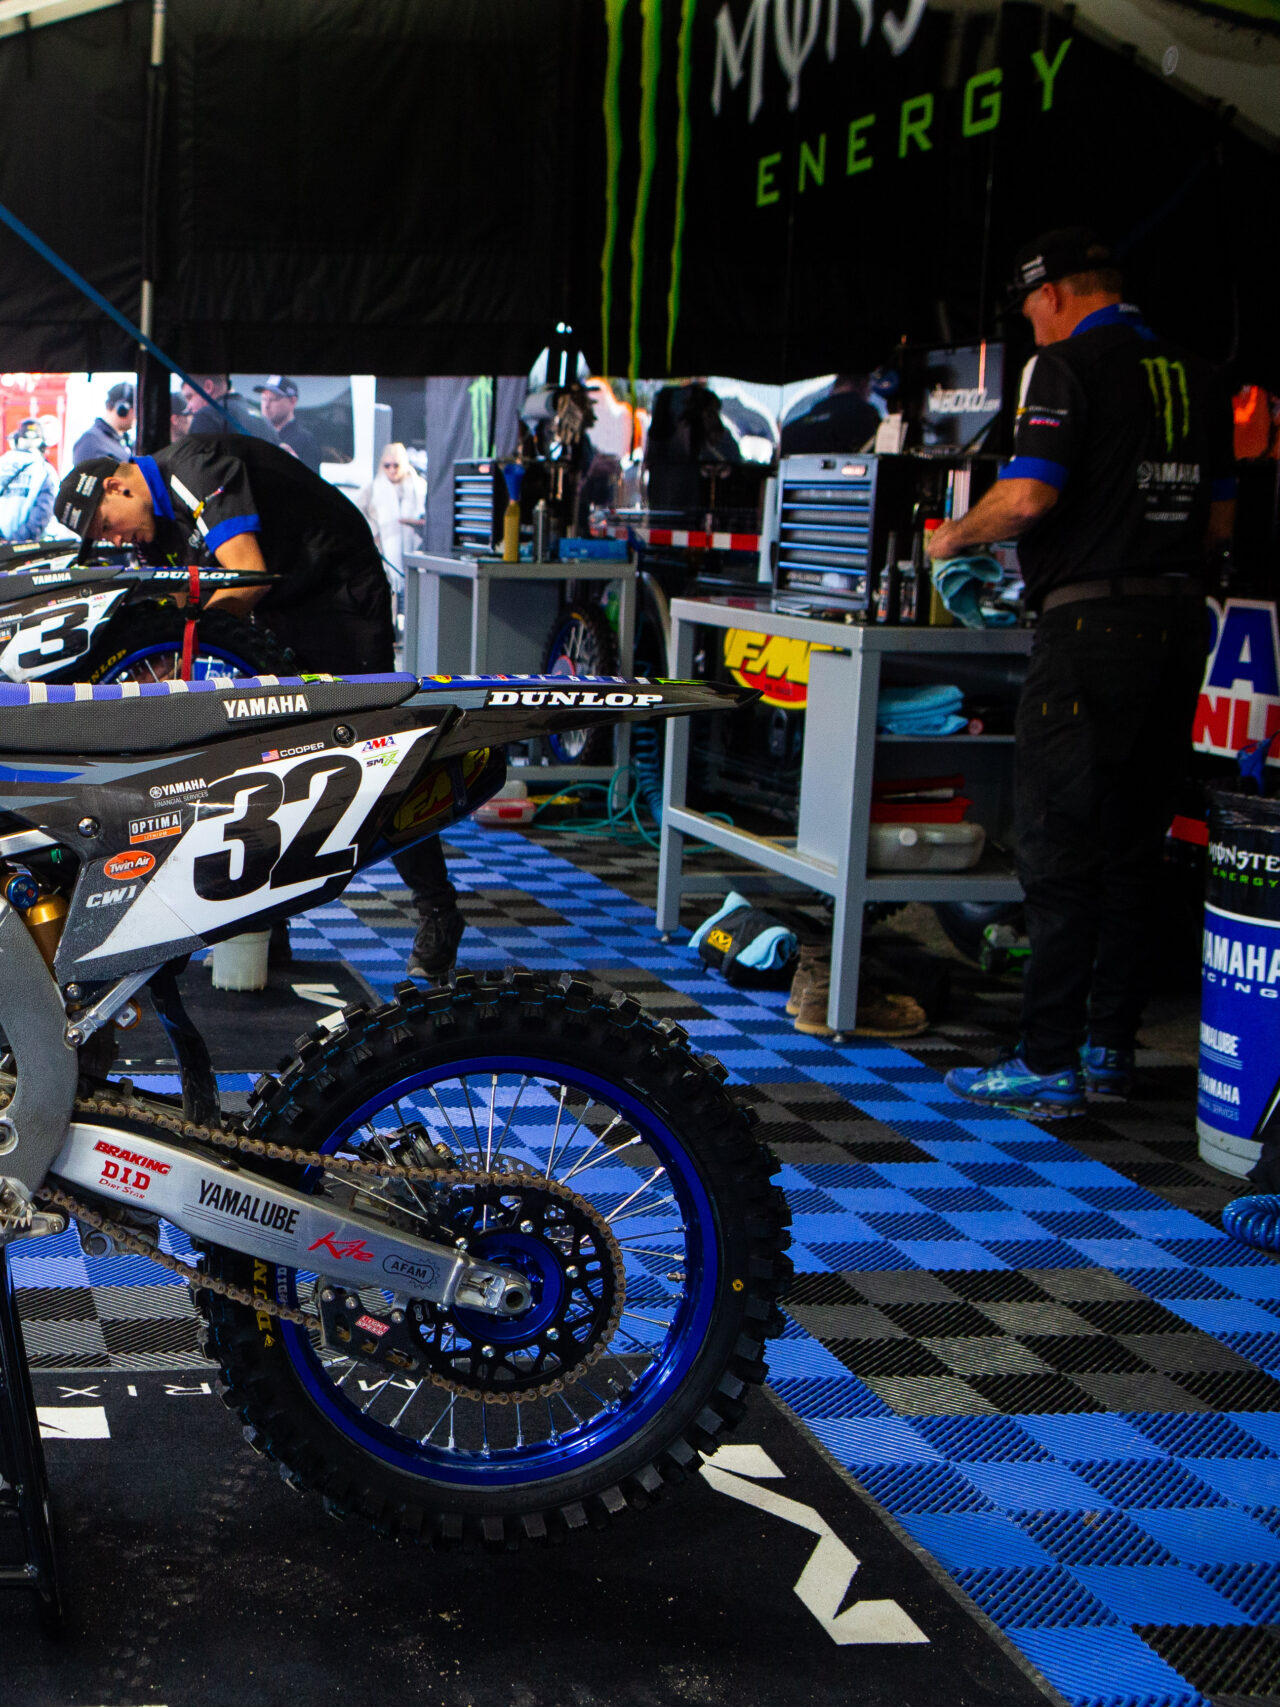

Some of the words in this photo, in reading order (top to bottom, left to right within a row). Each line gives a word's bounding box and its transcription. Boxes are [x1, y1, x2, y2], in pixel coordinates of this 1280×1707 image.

[756, 37, 1073, 207] ENERGY
[32, 573, 71, 586] YAMAHA
[17, 602, 90, 670] 3
[223, 693, 308, 719] YAMAHA
[488, 691, 663, 708] DUNLOP
[280, 741, 325, 758] COOPER
[362, 736, 397, 752] AMA
[162, 778, 208, 796] YAMAHA
[153, 796, 183, 809] FINANCIAL
[183, 791, 209, 802] SERVICES
[131, 813, 180, 835] OPTIMA
[193, 754, 363, 901] 32
[109, 861, 134, 875] Twin
[135, 855, 151, 868] Air
[1208, 841, 1280, 873] MONSTE
[1212, 866, 1279, 888] ENERGY
[93, 1139, 173, 1176] BRAKING
[198, 1179, 300, 1235] YAMALUBE
[307, 1231, 376, 1263] Kite
[391, 1260, 429, 1279] AFAM
[356, 1321, 386, 1337] SPEED
[358, 1314, 390, 1332] LIGHT
